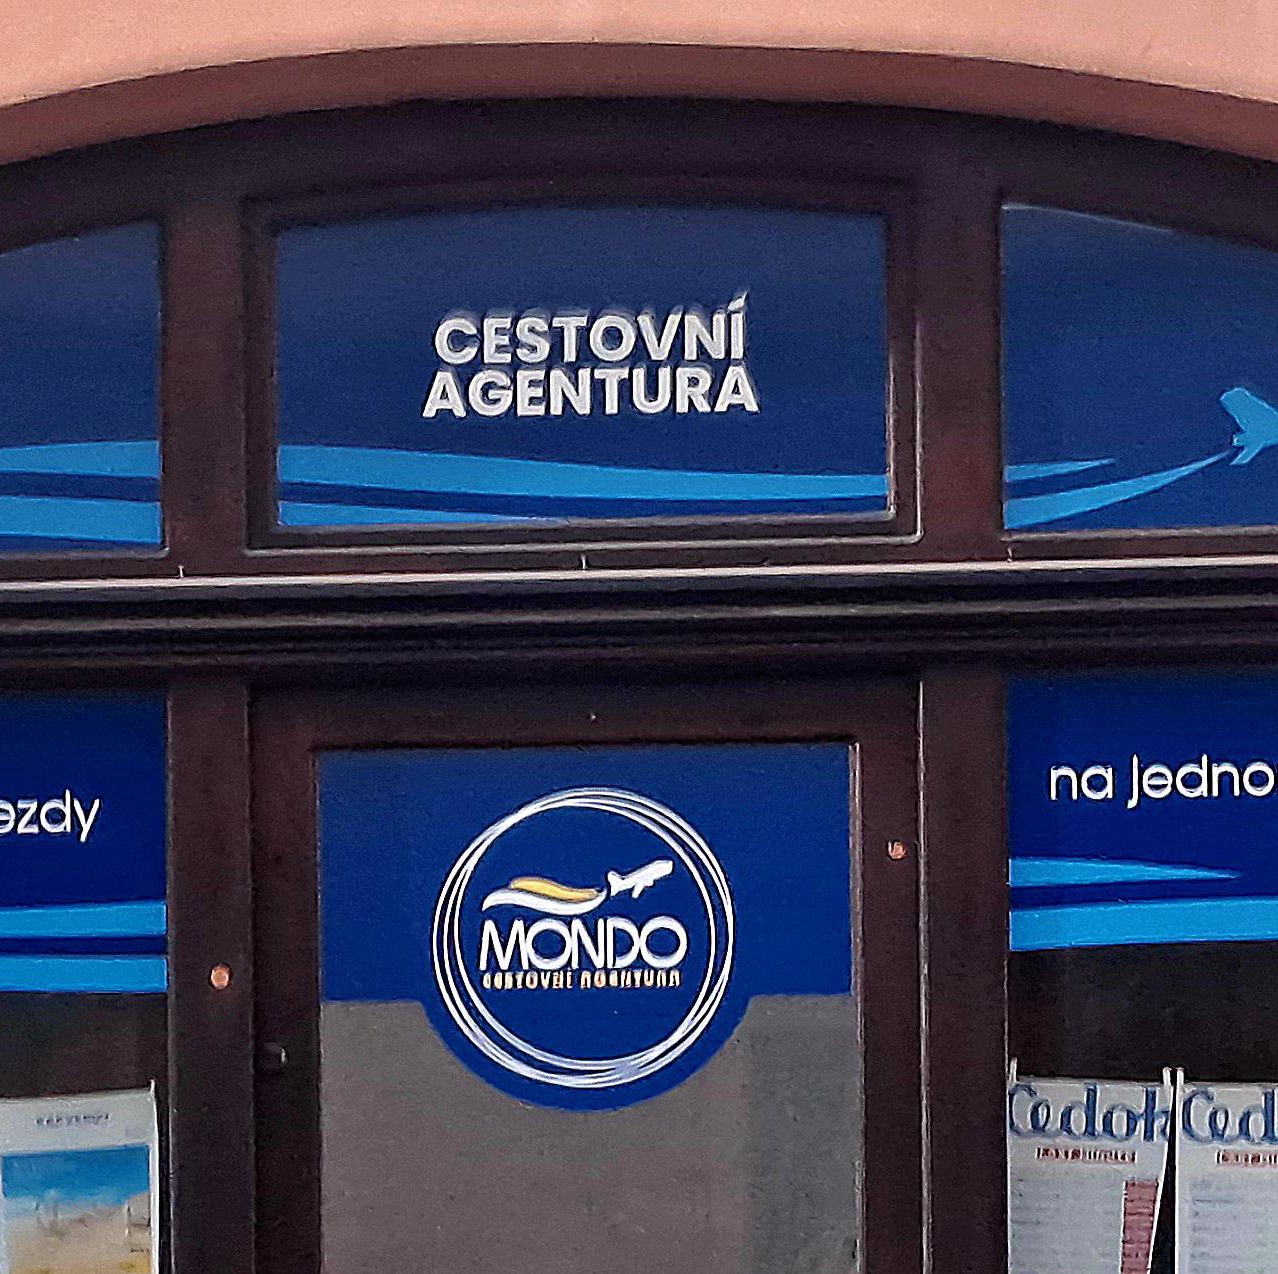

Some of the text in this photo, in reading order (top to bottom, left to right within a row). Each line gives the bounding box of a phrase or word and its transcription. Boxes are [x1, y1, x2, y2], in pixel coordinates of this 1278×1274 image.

[434, 291, 749, 365] CESTOVNÍ
[423, 364, 759, 419] AGENTURA
[1049, 763, 1114, 801] na
[479, 914, 689, 971] MONDO
